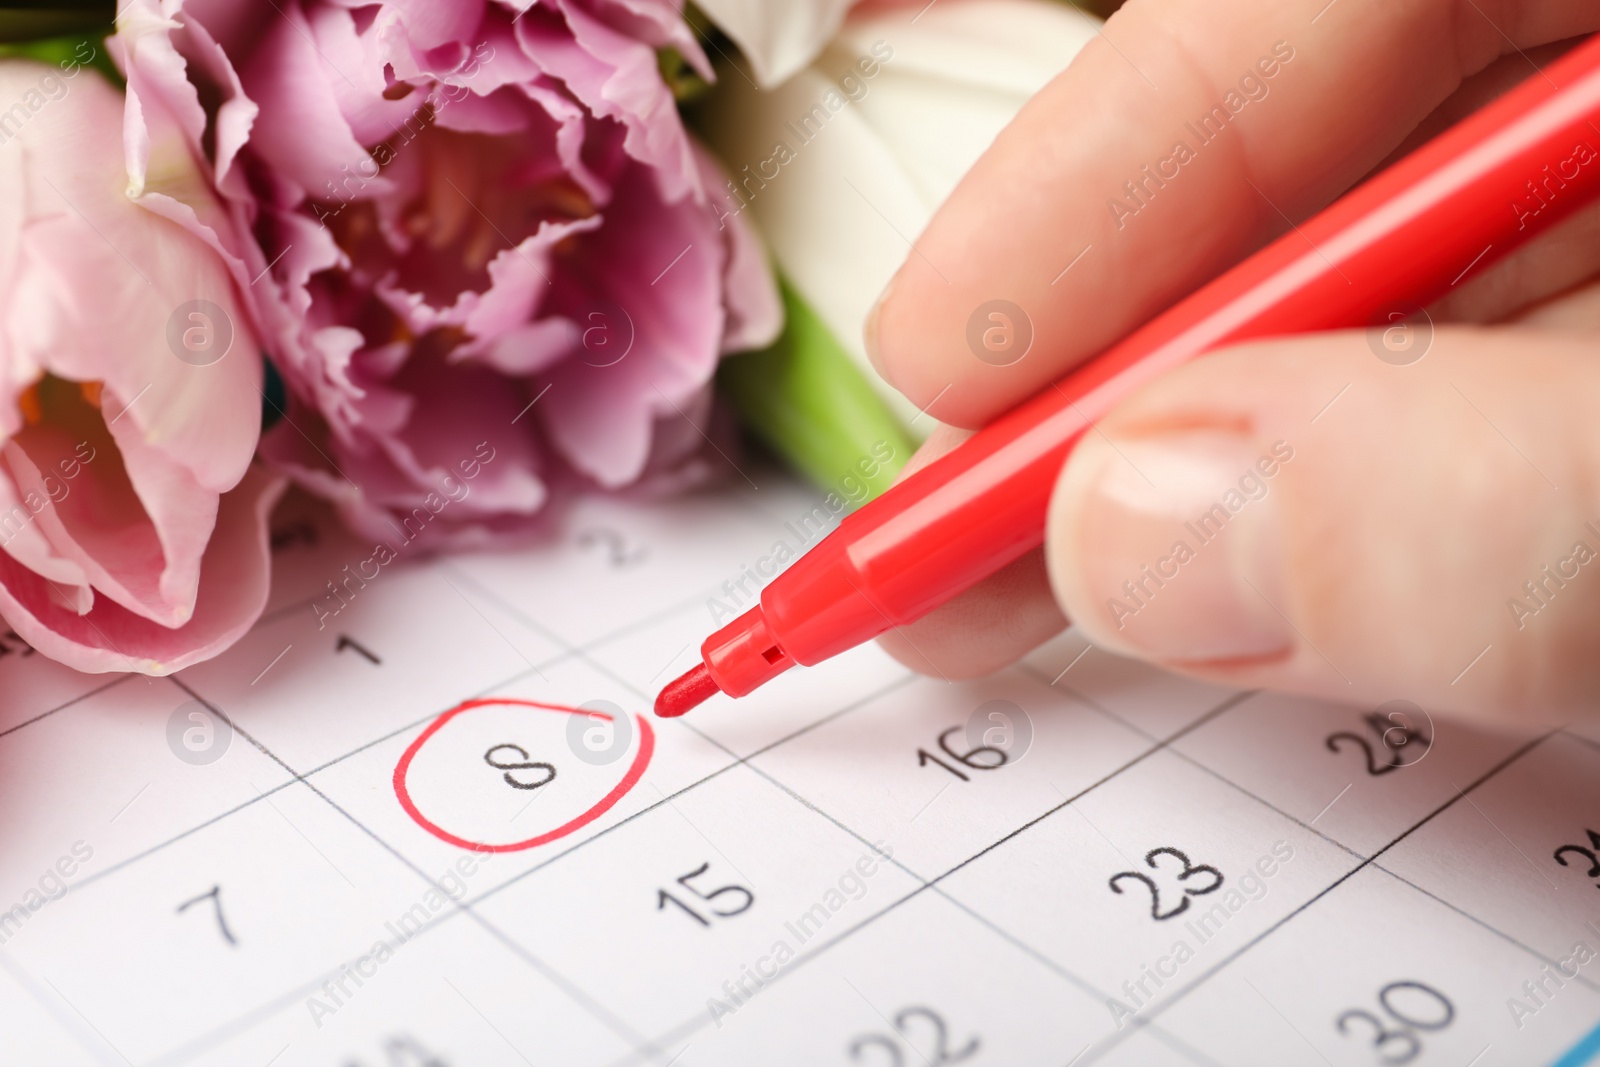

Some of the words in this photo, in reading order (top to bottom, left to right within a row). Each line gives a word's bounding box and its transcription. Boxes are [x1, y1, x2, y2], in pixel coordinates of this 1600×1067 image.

[335, 634, 382, 666] 1
[484, 743, 556, 790] 8
[918, 725, 1008, 781] 16
[1324, 711, 1433, 776] 24
[658, 862, 754, 927] 15
[1109, 847, 1224, 920] 23
[176, 884, 238, 946] 7
[845, 1005, 982, 1067] 22
[1335, 979, 1456, 1066] 30
